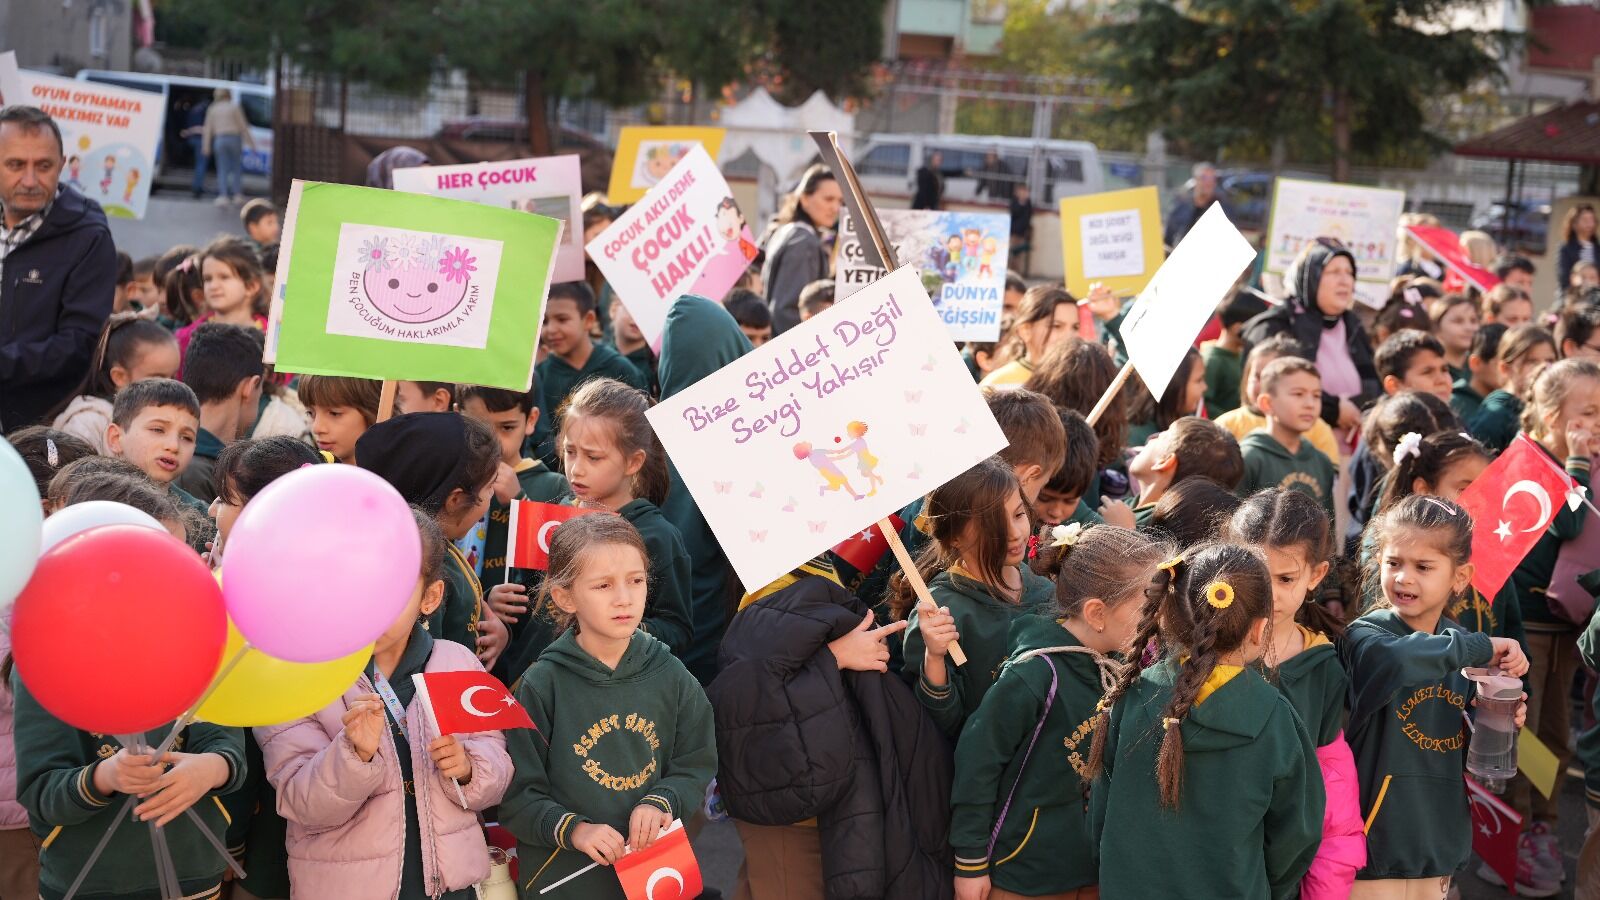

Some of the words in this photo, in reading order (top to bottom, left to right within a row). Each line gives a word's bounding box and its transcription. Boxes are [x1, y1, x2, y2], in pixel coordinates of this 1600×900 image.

[32, 85, 70, 101] OYUN
[73, 91, 142, 113] OYNAMAYA
[106, 114, 131, 129] VAR
[437, 173, 473, 190] HER
[478, 166, 537, 191] ÇOCUK
[603, 217, 646, 261] ÇOCUK
[644, 195, 670, 226] AKLI
[668, 169, 696, 203] DEME
[631, 203, 696, 277] ÇOCUK
[651, 224, 716, 299] HAKLI!
[349, 271, 361, 295] BEN
[944, 283, 998, 301] DÜNYA
[462, 285, 480, 316] VARIM
[348, 297, 395, 336] ÇOCUĞUM
[397, 317, 465, 339] HAKLARIMLA
[682, 397, 740, 432] Bize
[745, 334, 830, 401] Şiddet
[833, 293, 903, 347] Değil
[731, 392, 802, 444] Sevgi
[801, 348, 890, 399] Yakışır
